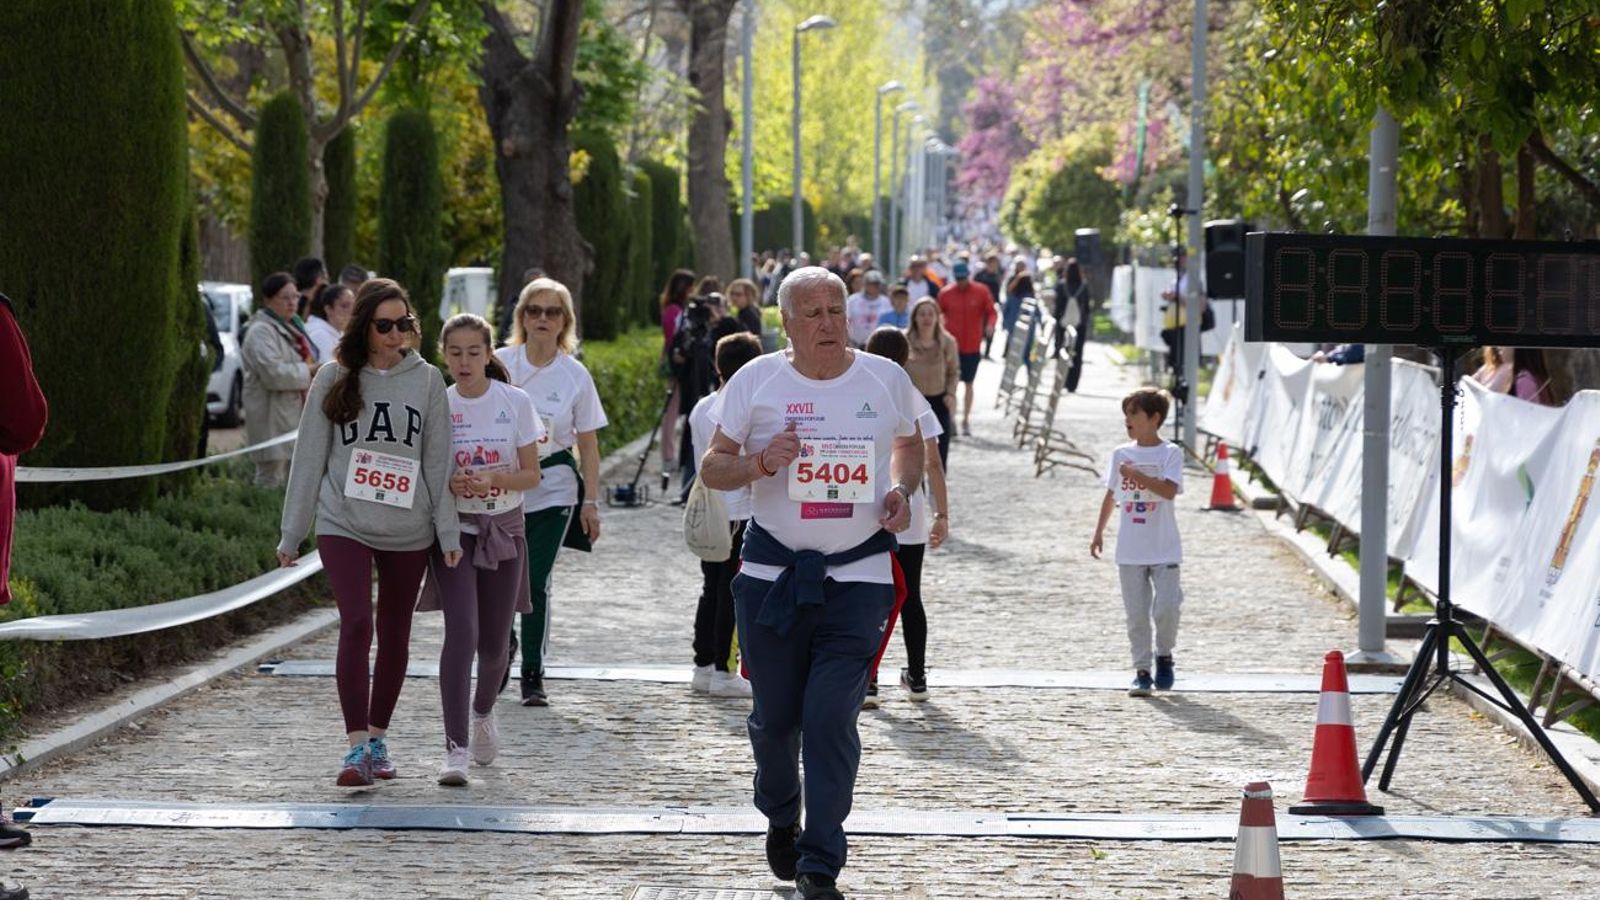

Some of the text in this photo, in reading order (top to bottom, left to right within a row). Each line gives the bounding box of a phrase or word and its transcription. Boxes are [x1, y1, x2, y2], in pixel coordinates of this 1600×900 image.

[786, 402, 814, 414] XXVII
[353, 467, 411, 493] 5658
[796, 462, 869, 485] 5404
